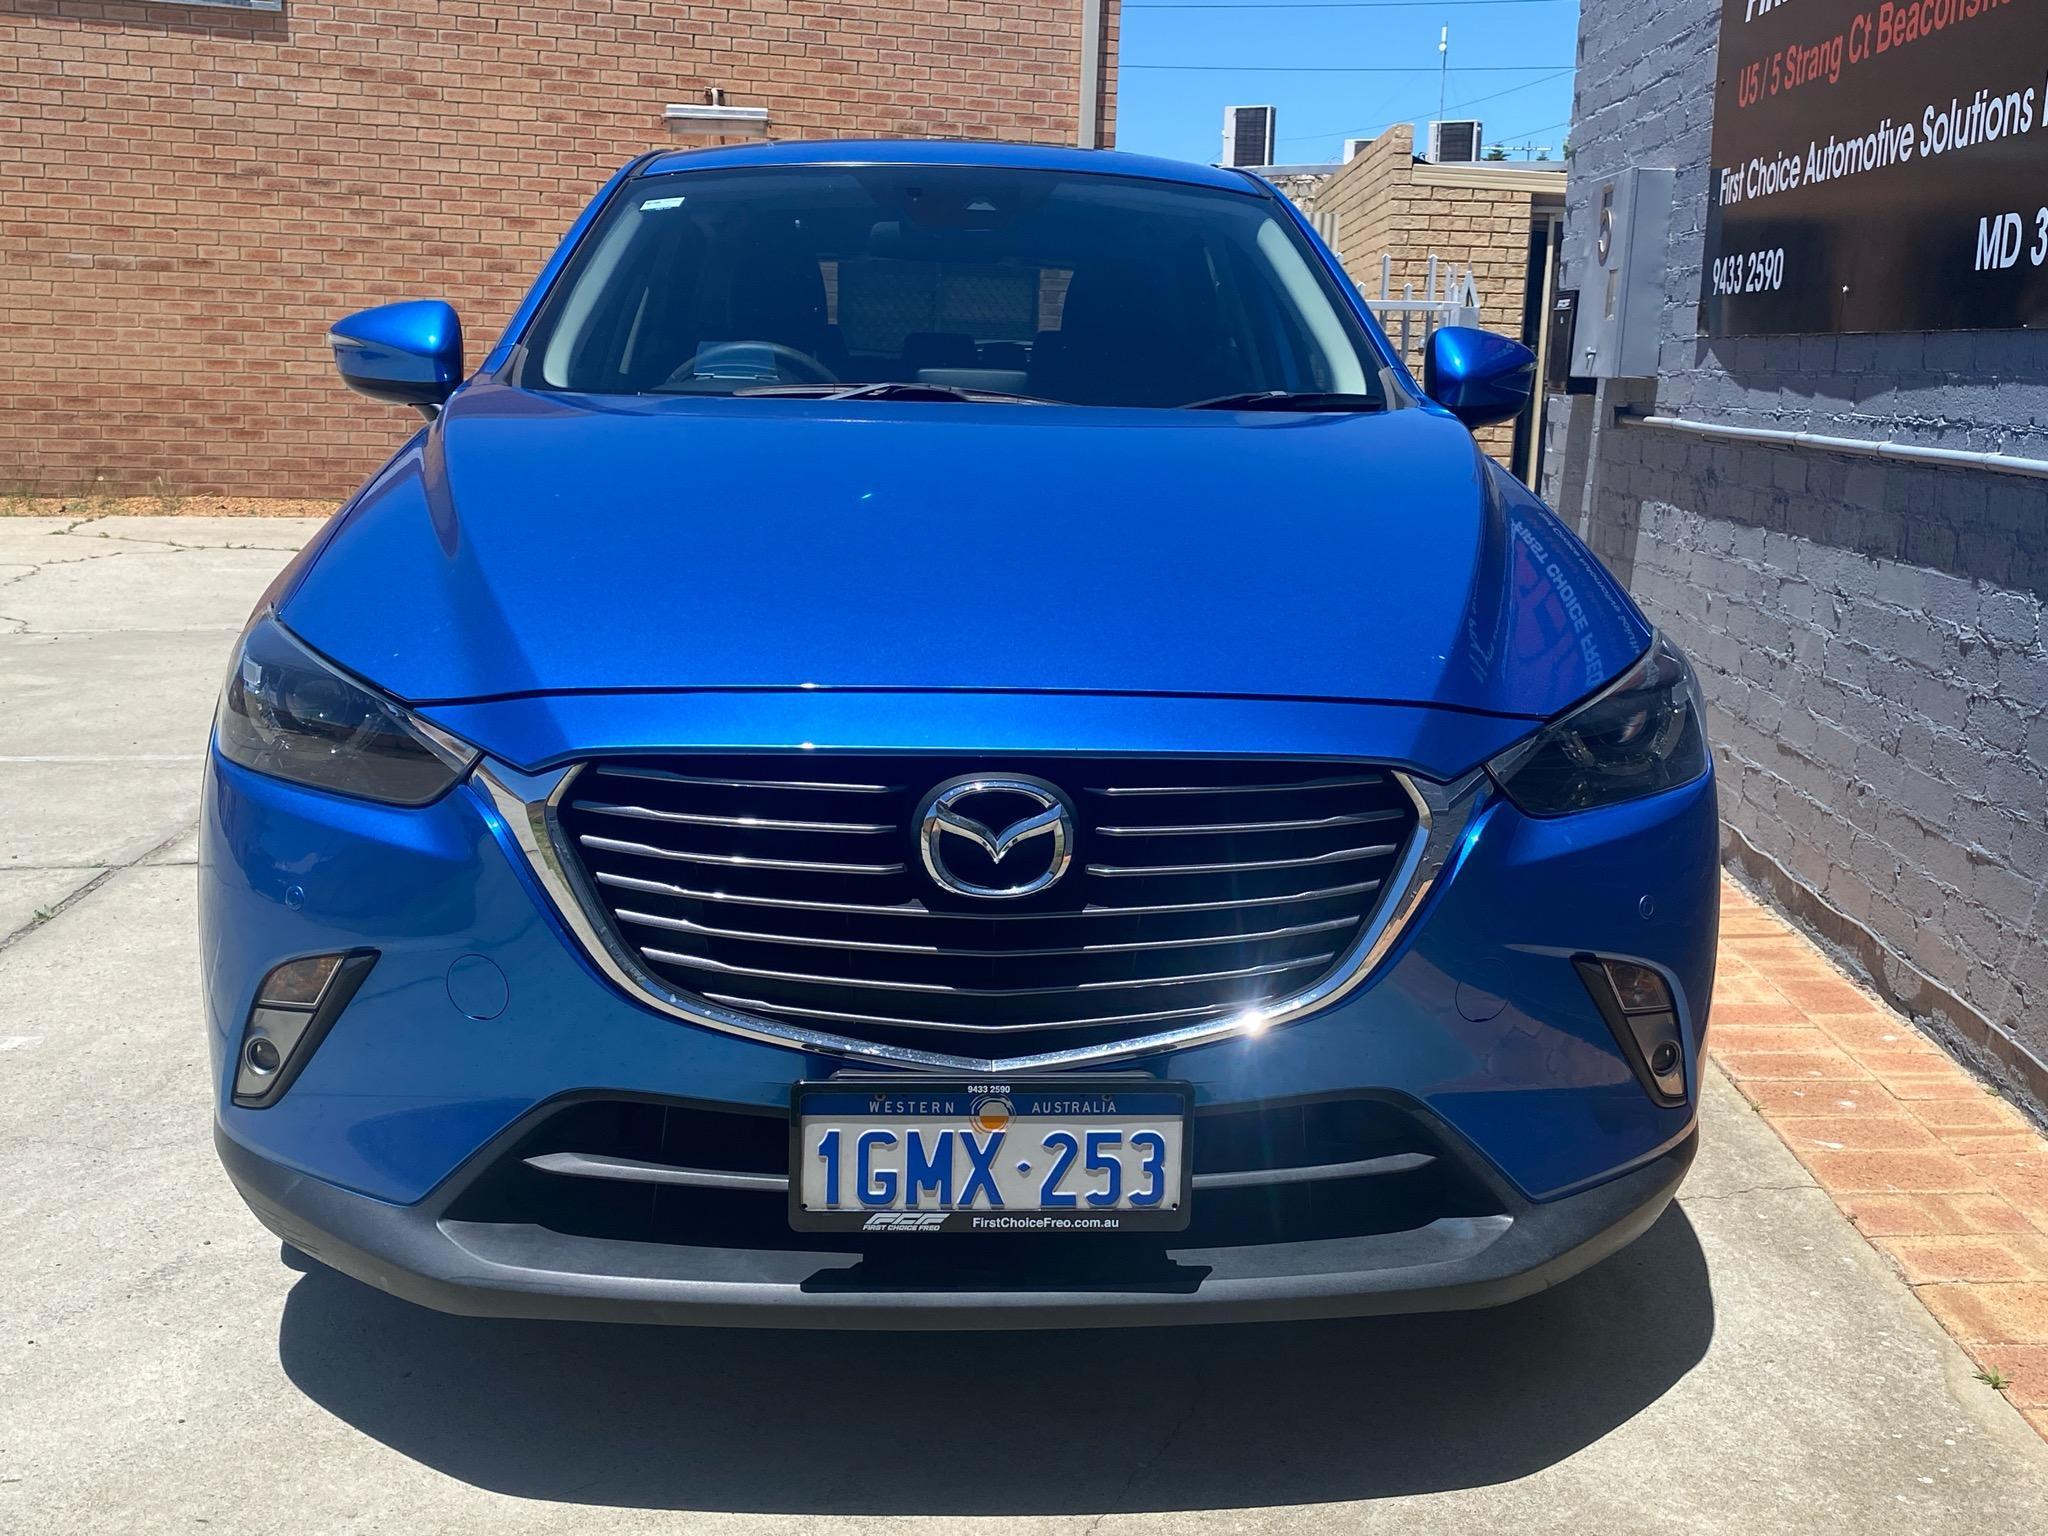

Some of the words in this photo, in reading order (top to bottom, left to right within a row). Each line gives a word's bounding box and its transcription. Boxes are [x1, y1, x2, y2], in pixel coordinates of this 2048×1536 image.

[1738, 66, 1760, 109] U5
[1770, 52, 1782, 96] 5
[1784, 35, 1843, 89] Strang
[1849, 12, 1872, 64] Ct
[1718, 163, 1744, 206] First
[1746, 152, 1800, 200] Choice
[1803, 119, 1914, 186] Automotive
[1920, 87, 2035, 158] Solutions
[1975, 212, 2023, 271] MD
[1712, 254, 1742, 296] 9433
[1745, 248, 1784, 293] 2590
[869, 1101, 954, 1113] WESTERN
[1031, 1101, 1117, 1113] AUSTRALIA
[967, 1085, 988, 1093] 9433
[990, 1085, 1010, 1093] 2590
[972, 1217, 1119, 1228] FirstChoiceFreo.com.au
